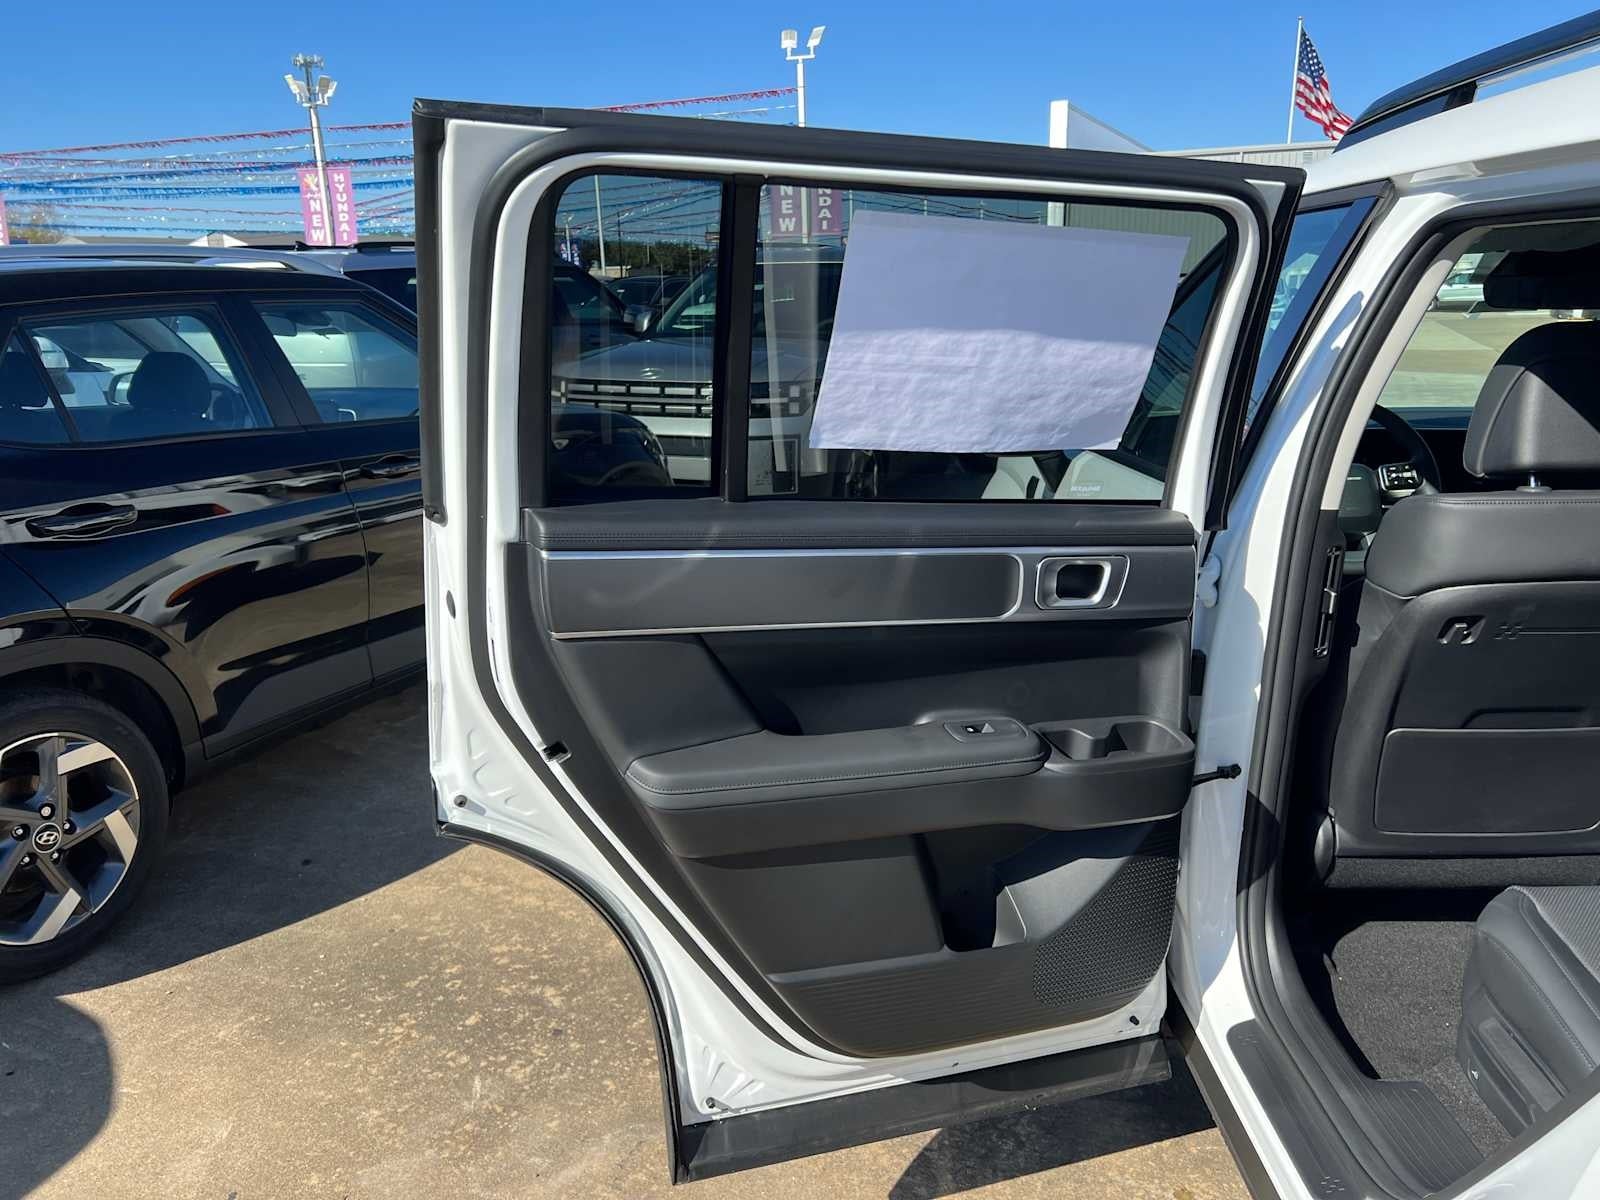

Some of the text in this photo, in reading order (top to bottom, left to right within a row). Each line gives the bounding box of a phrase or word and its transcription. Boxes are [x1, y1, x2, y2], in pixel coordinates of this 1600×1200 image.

[309, 199, 325, 242] NEW
[333, 173, 350, 241] HYUNDAI
[779, 186, 796, 232] NEW
